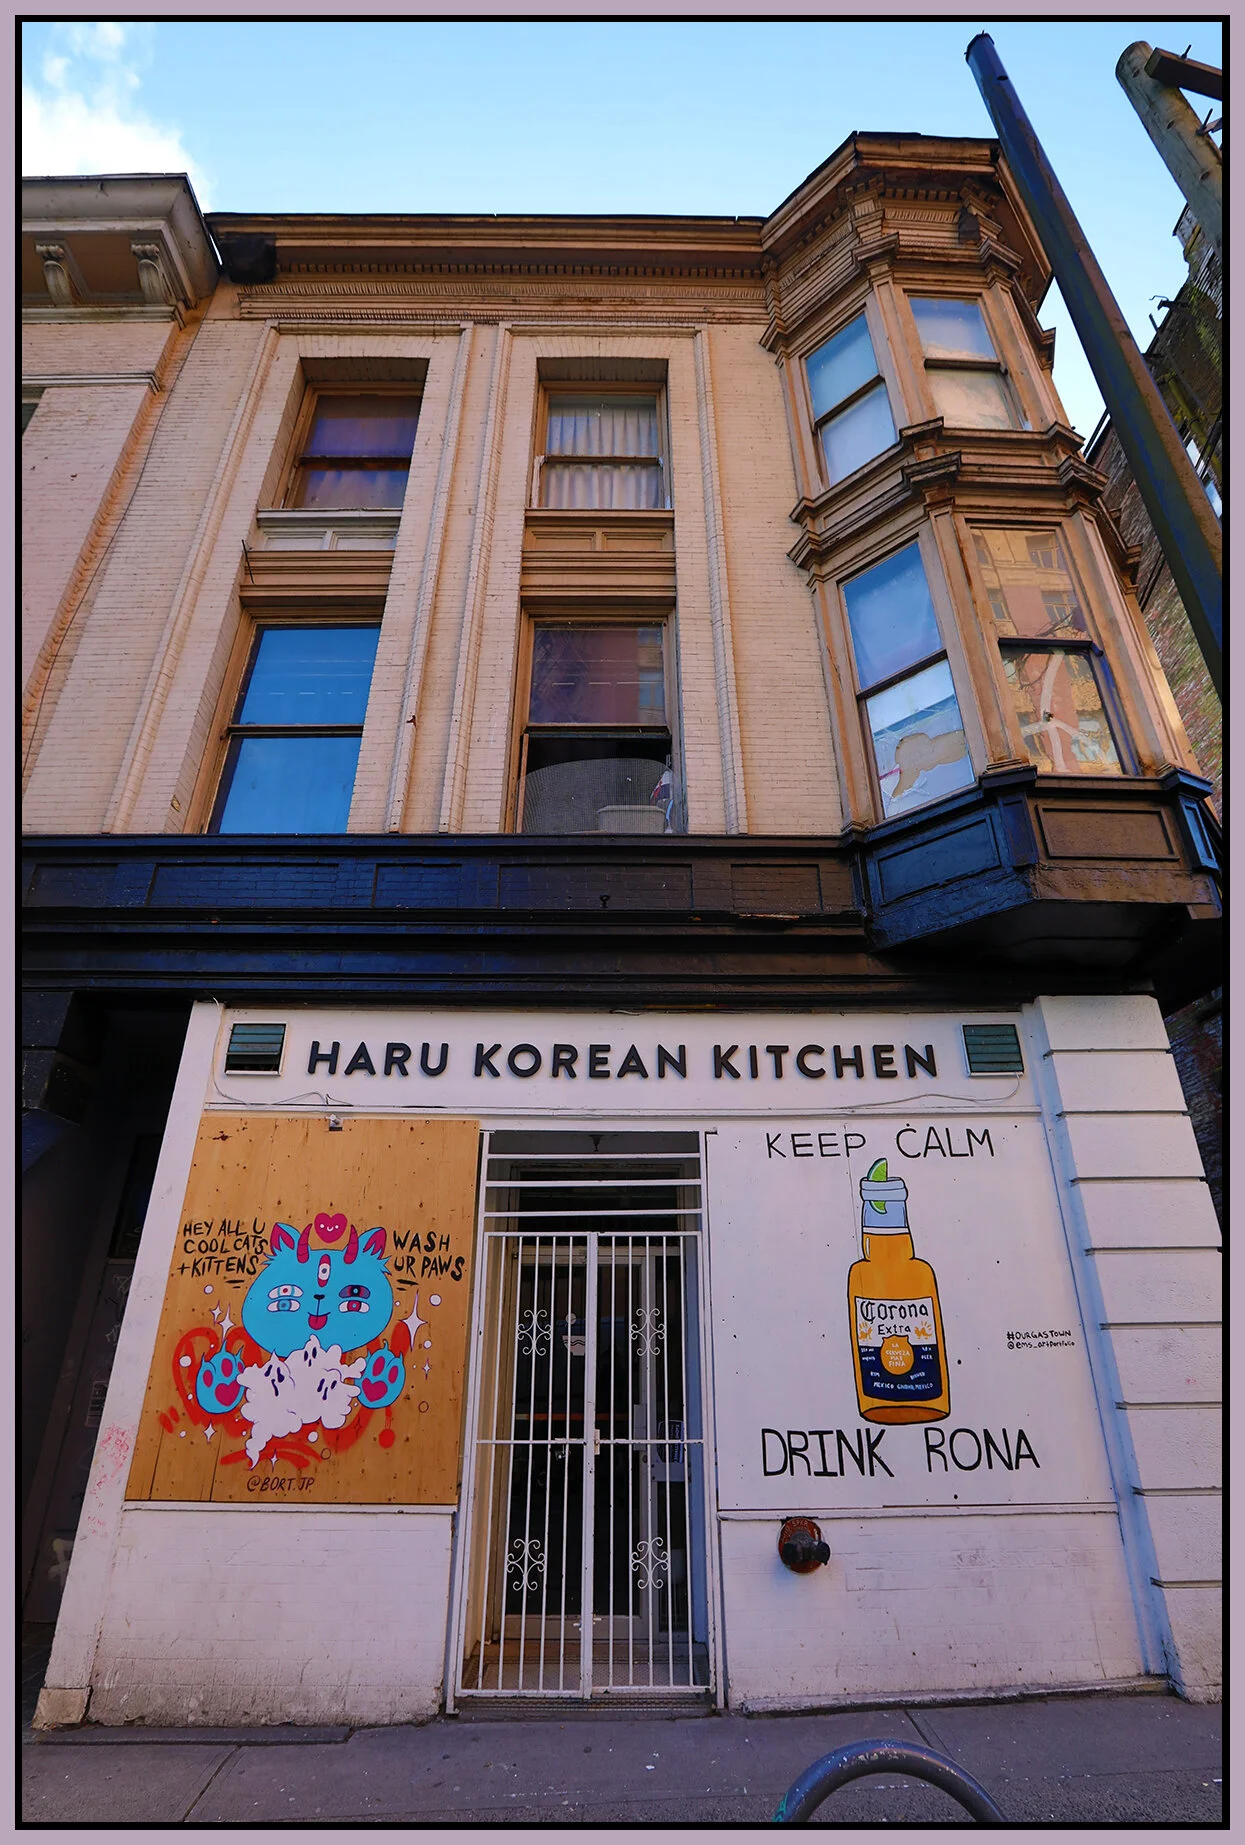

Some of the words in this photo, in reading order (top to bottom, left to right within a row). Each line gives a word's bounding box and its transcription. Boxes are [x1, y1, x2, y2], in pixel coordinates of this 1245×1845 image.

[307, 1040, 449, 1077] HARU
[474, 1042, 687, 1079] KOREAN
[713, 1043, 938, 1079] KITCHEN
[766, 1132, 866, 1159] KEEP
[896, 1126, 995, 1159] CALM
[183, 1220, 213, 1237] HEY
[218, 1218, 247, 1237] ALL
[253, 1217, 266, 1235] U
[184, 1238, 230, 1254] COOL
[234, 1234, 268, 1255] CATS
[393, 1229, 450, 1254] WASH
[394, 1255, 416, 1278] UR
[421, 1254, 465, 1281] PAWS
[860, 1300, 929, 1324] Corona
[877, 1324, 911, 1335] Extra
[761, 1428, 895, 1477] DRINK
[924, 1427, 1040, 1472] RONA
[247, 1475, 315, 1492] @BORT.JP
